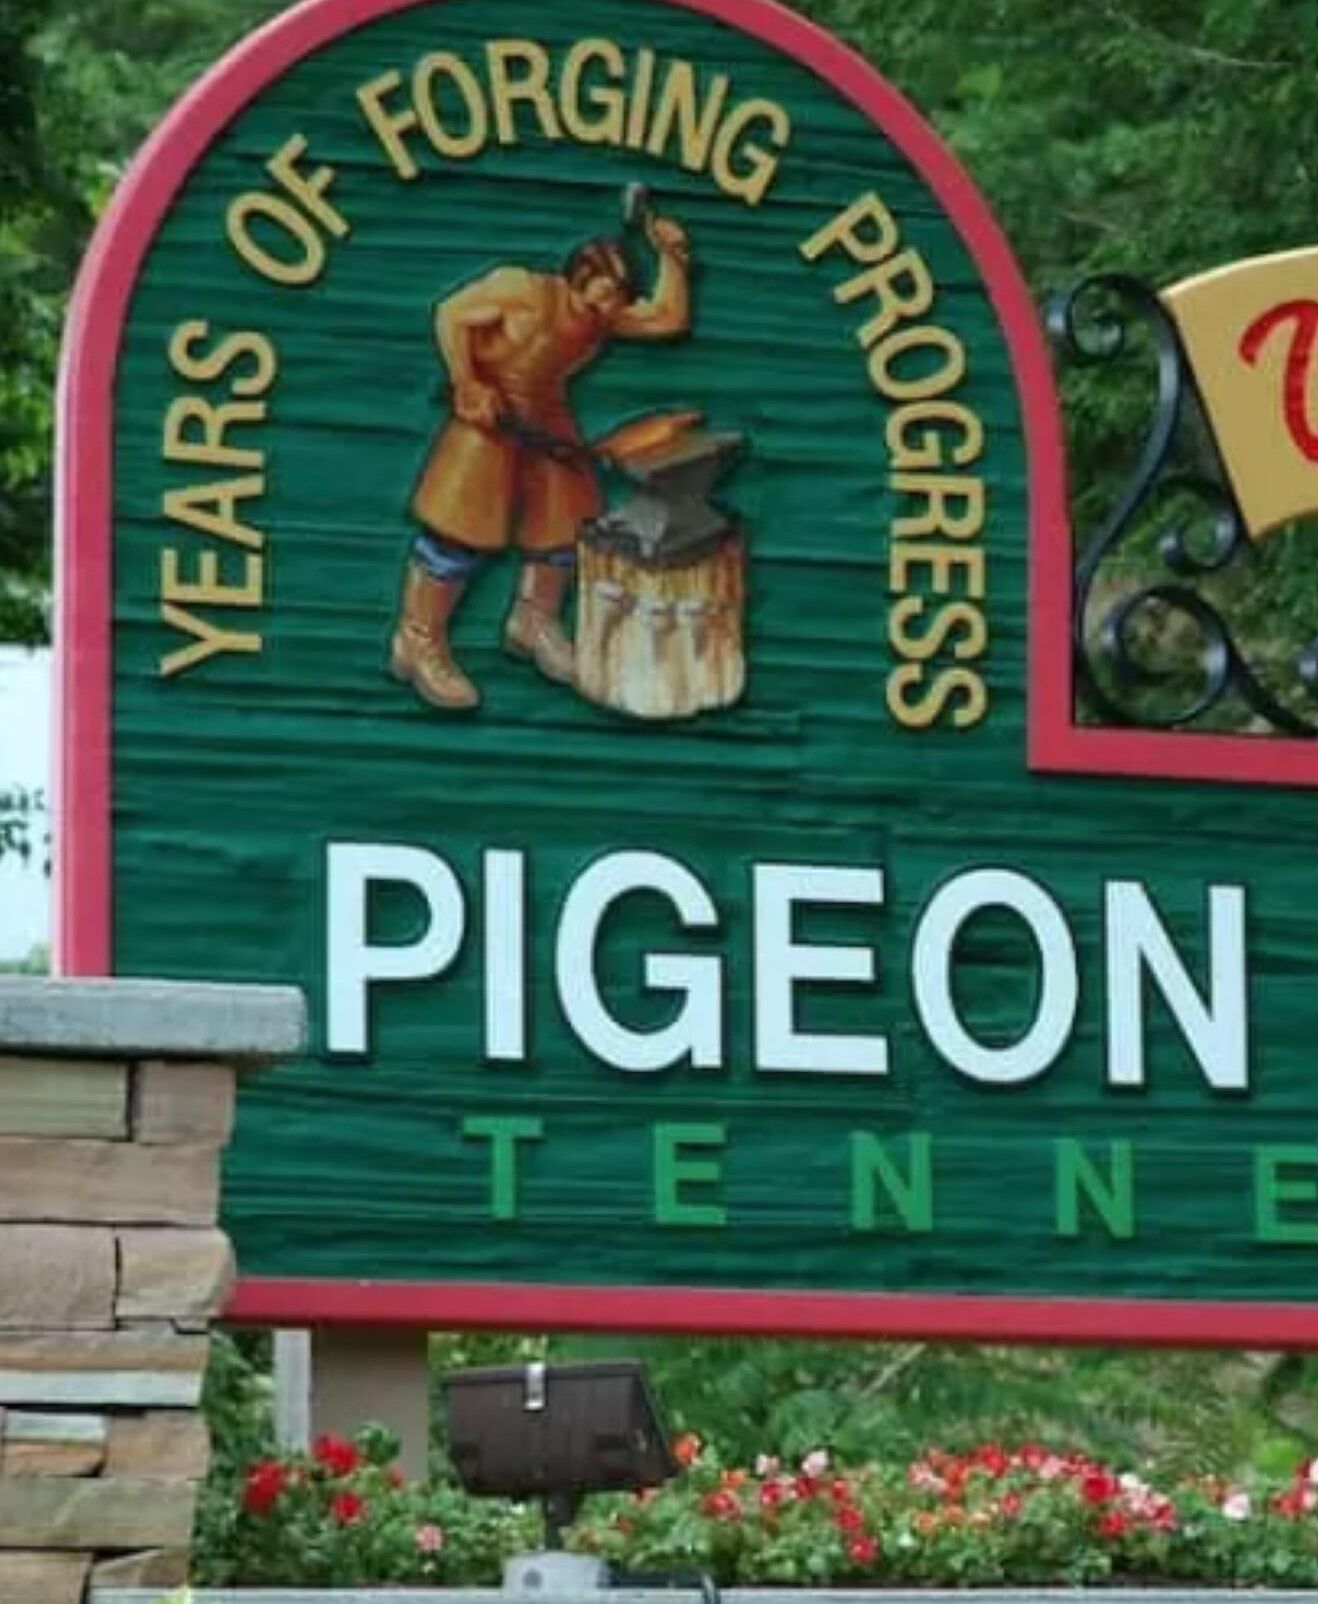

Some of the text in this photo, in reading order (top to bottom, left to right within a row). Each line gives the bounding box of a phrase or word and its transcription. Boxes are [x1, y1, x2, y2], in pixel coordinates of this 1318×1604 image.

[160, 38, 986, 730] YEARS OF FORGING PROGRESS
[325, 841, 1249, 1090] PIGEON
